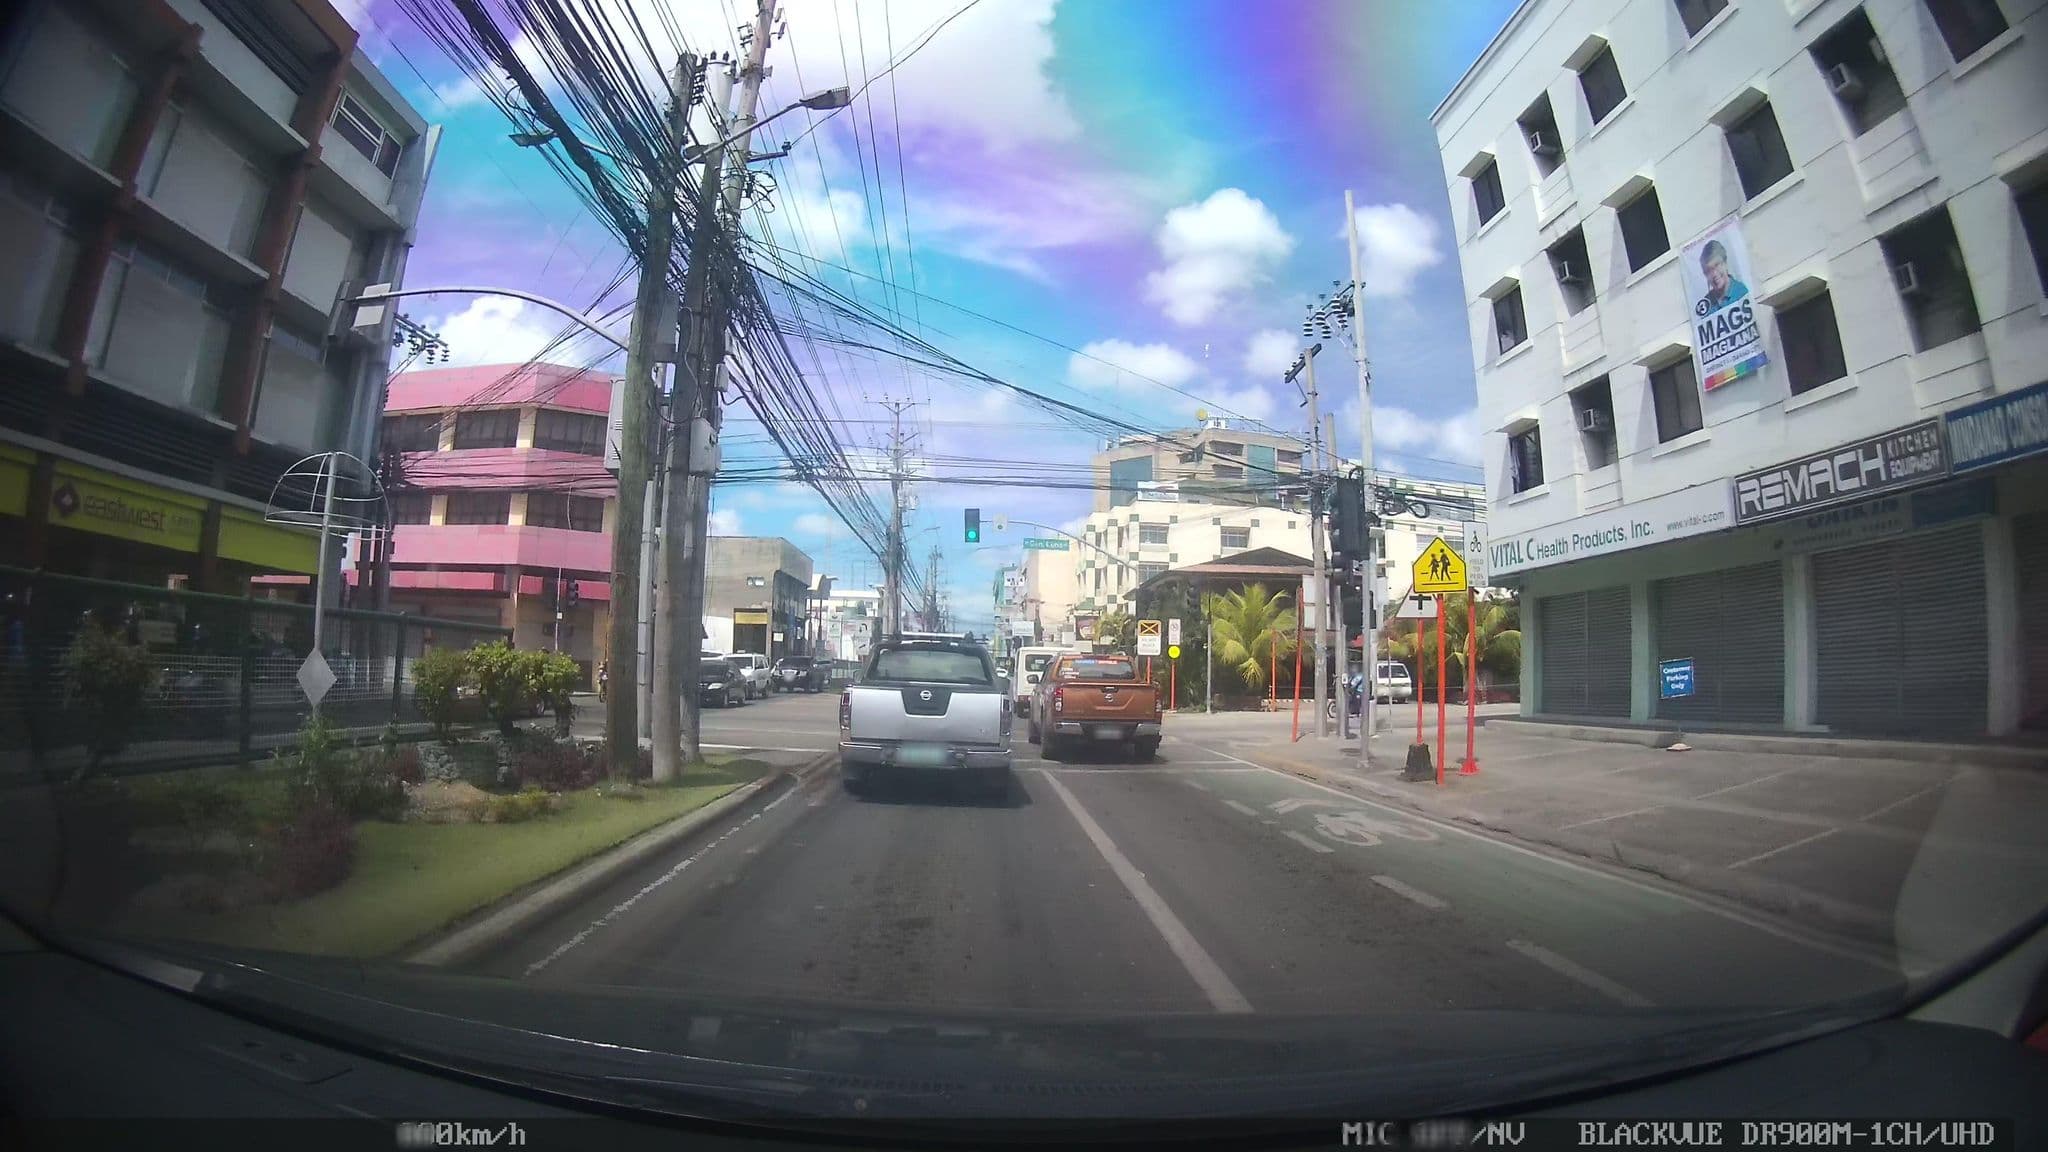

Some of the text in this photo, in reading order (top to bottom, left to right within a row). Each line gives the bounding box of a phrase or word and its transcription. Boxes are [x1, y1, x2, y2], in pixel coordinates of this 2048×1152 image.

[1698, 299, 1753, 346] MAGS
[1702, 326, 1760, 363] MAGLANA
[1886, 427, 1938, 459] KITCHEN
[1889, 448, 1940, 479] EQUIPMENT
[1738, 443, 1887, 516] REMACH
[1490, 541, 1524, 569] VITAL
[1526, 537, 1535, 561] C
[1537, 539, 1569, 559] Health
[1630, 519, 1654, 538] Inc.
